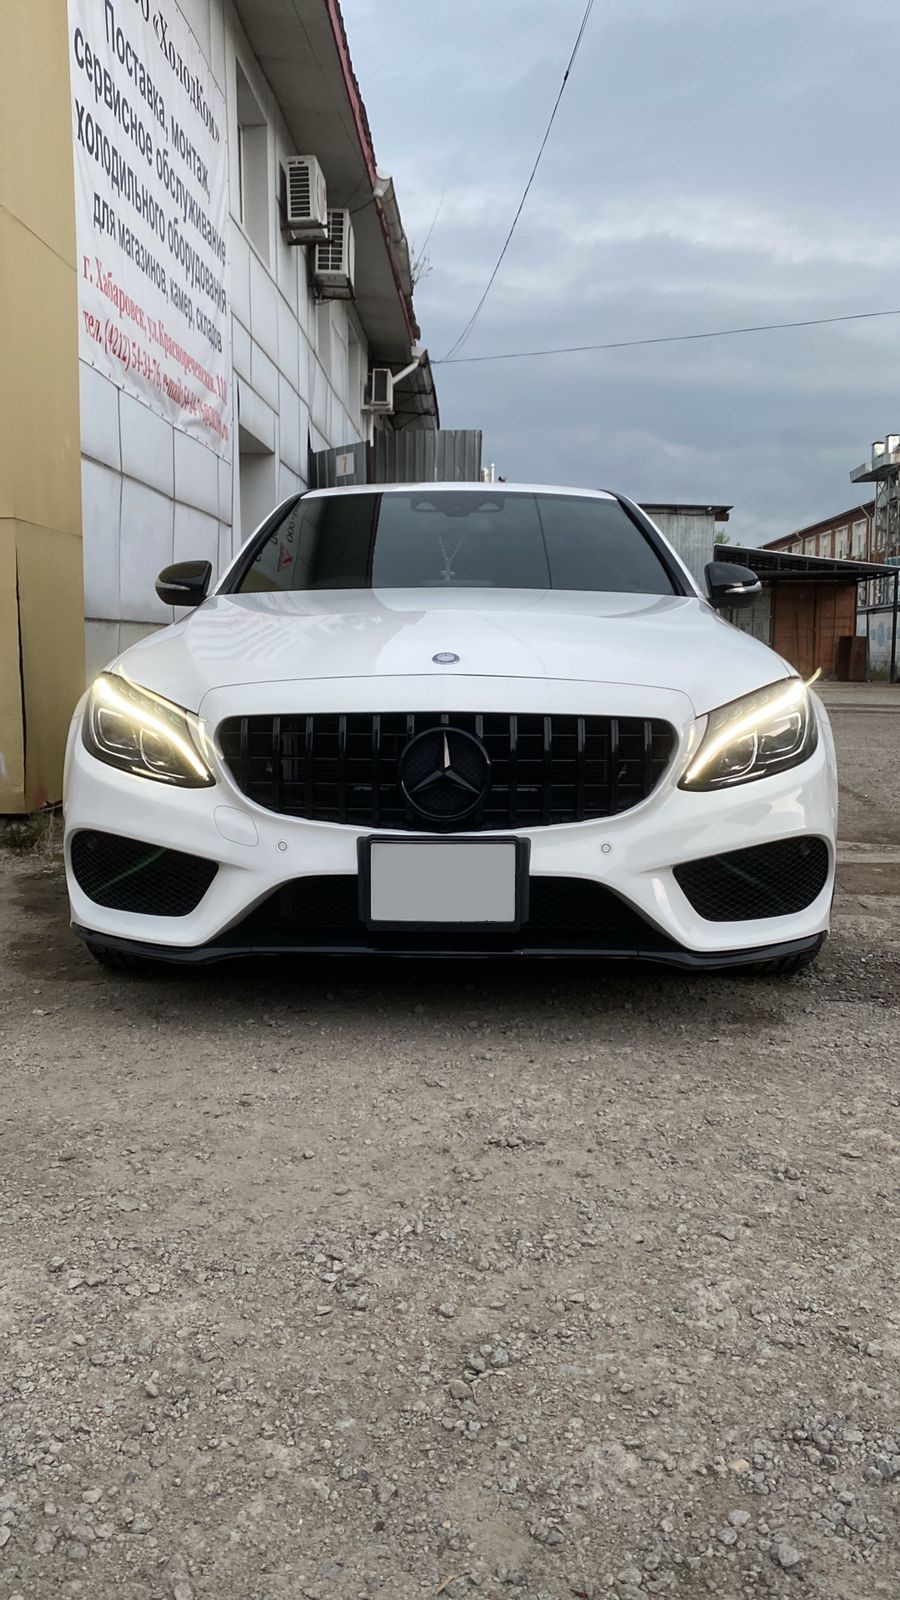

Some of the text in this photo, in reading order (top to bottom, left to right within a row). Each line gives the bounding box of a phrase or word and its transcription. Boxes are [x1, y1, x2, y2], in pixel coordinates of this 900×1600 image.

[104, 0, 211, 204] Поставка, монтаж,
[152, 10, 220, 143] «ХолодКом»
[75, 99, 227, 316] холодильного оборудования
[82, 255, 93, 283] г.
[93, 191, 222, 354] для магазинов, камер, складов
[156, 148, 227, 267] обслуживание
[83, 310, 103, 345] тел.
